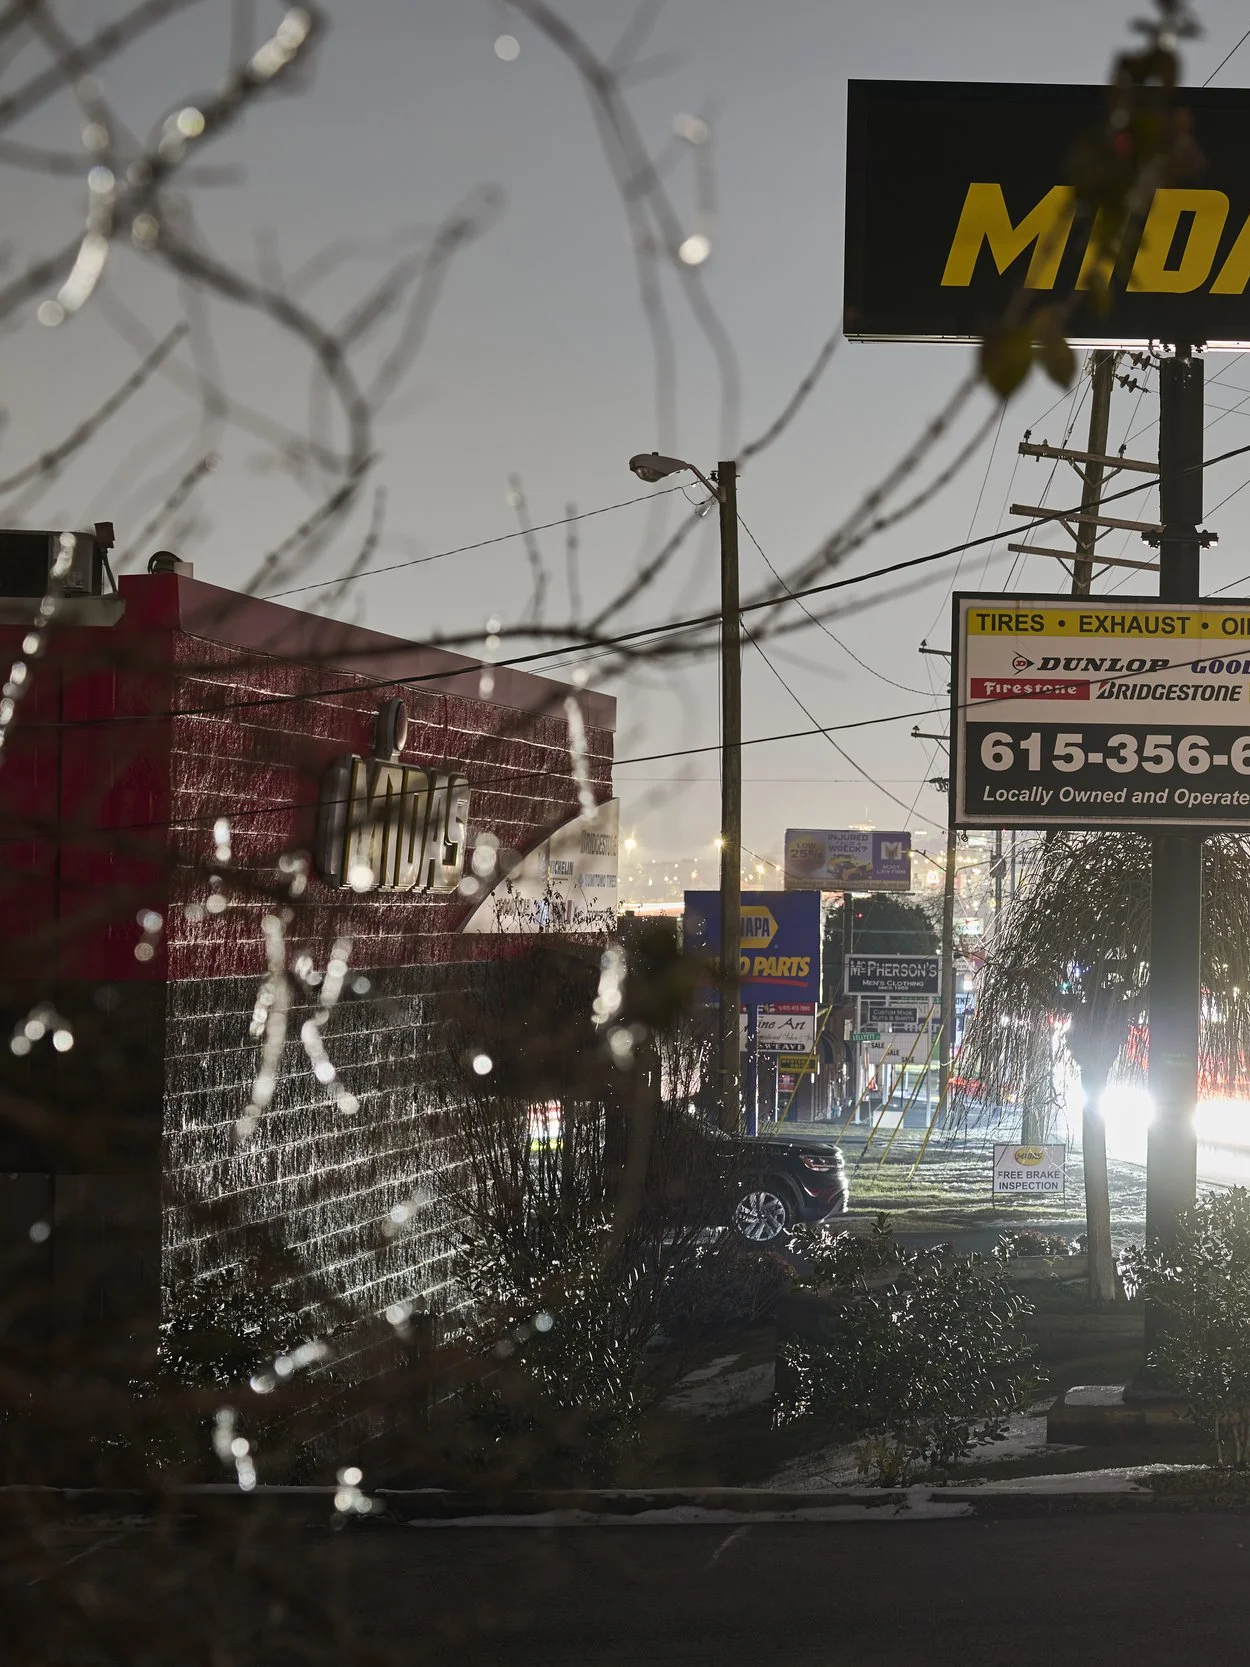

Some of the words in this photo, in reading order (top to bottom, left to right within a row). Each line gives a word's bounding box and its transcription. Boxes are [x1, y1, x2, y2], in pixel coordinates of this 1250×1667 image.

[976, 613, 1045, 633] TIRES
[1078, 614, 1191, 636] EXHAUST
[1036, 656, 1170, 673] DUNLOP
[984, 680, 1078, 697] Firestone
[1097, 680, 1243, 703] BRIDGESTONE
[983, 785, 1054, 806] Locally
[1058, 786, 1126, 804] Owned
[1131, 787, 1167, 805] and
[340, 755, 470, 894] MIDAS
[827, 833, 869, 841] INJURED
[753, 956, 811, 977] PARTS
[778, 1017, 806, 1030] Art
[997, 1170, 1023, 1179] FREE
[1026, 1170, 1061, 1179] BRAKE
[999, 1181, 1059, 1190] INSPECTION
